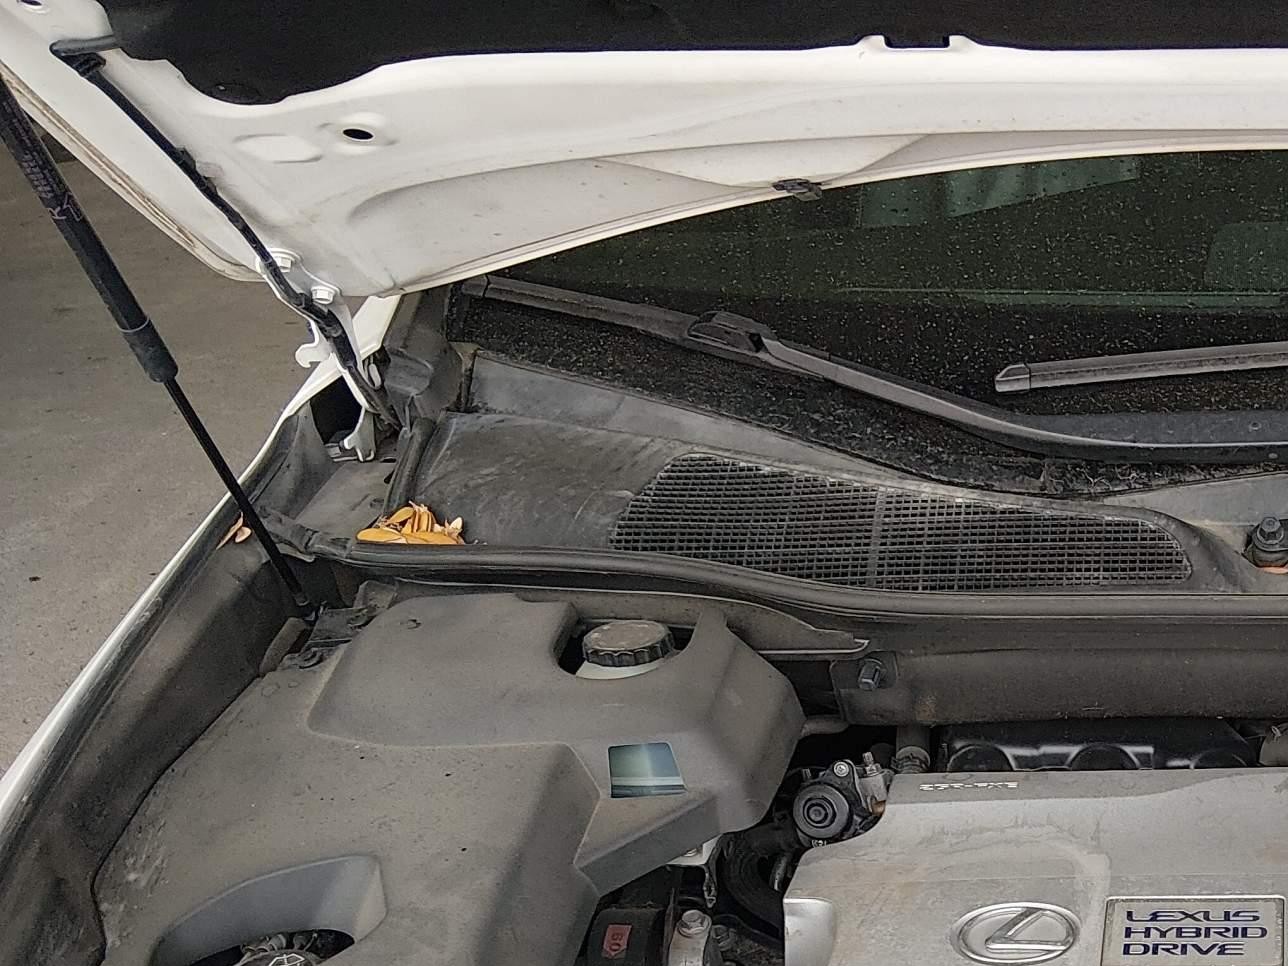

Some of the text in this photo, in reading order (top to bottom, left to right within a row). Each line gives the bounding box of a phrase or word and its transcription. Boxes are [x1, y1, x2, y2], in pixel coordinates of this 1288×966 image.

[1126, 910, 1260, 923] LEXUS
[1124, 926, 1268, 939] HYBRID
[1122, 943, 1245, 956] DRIVE
